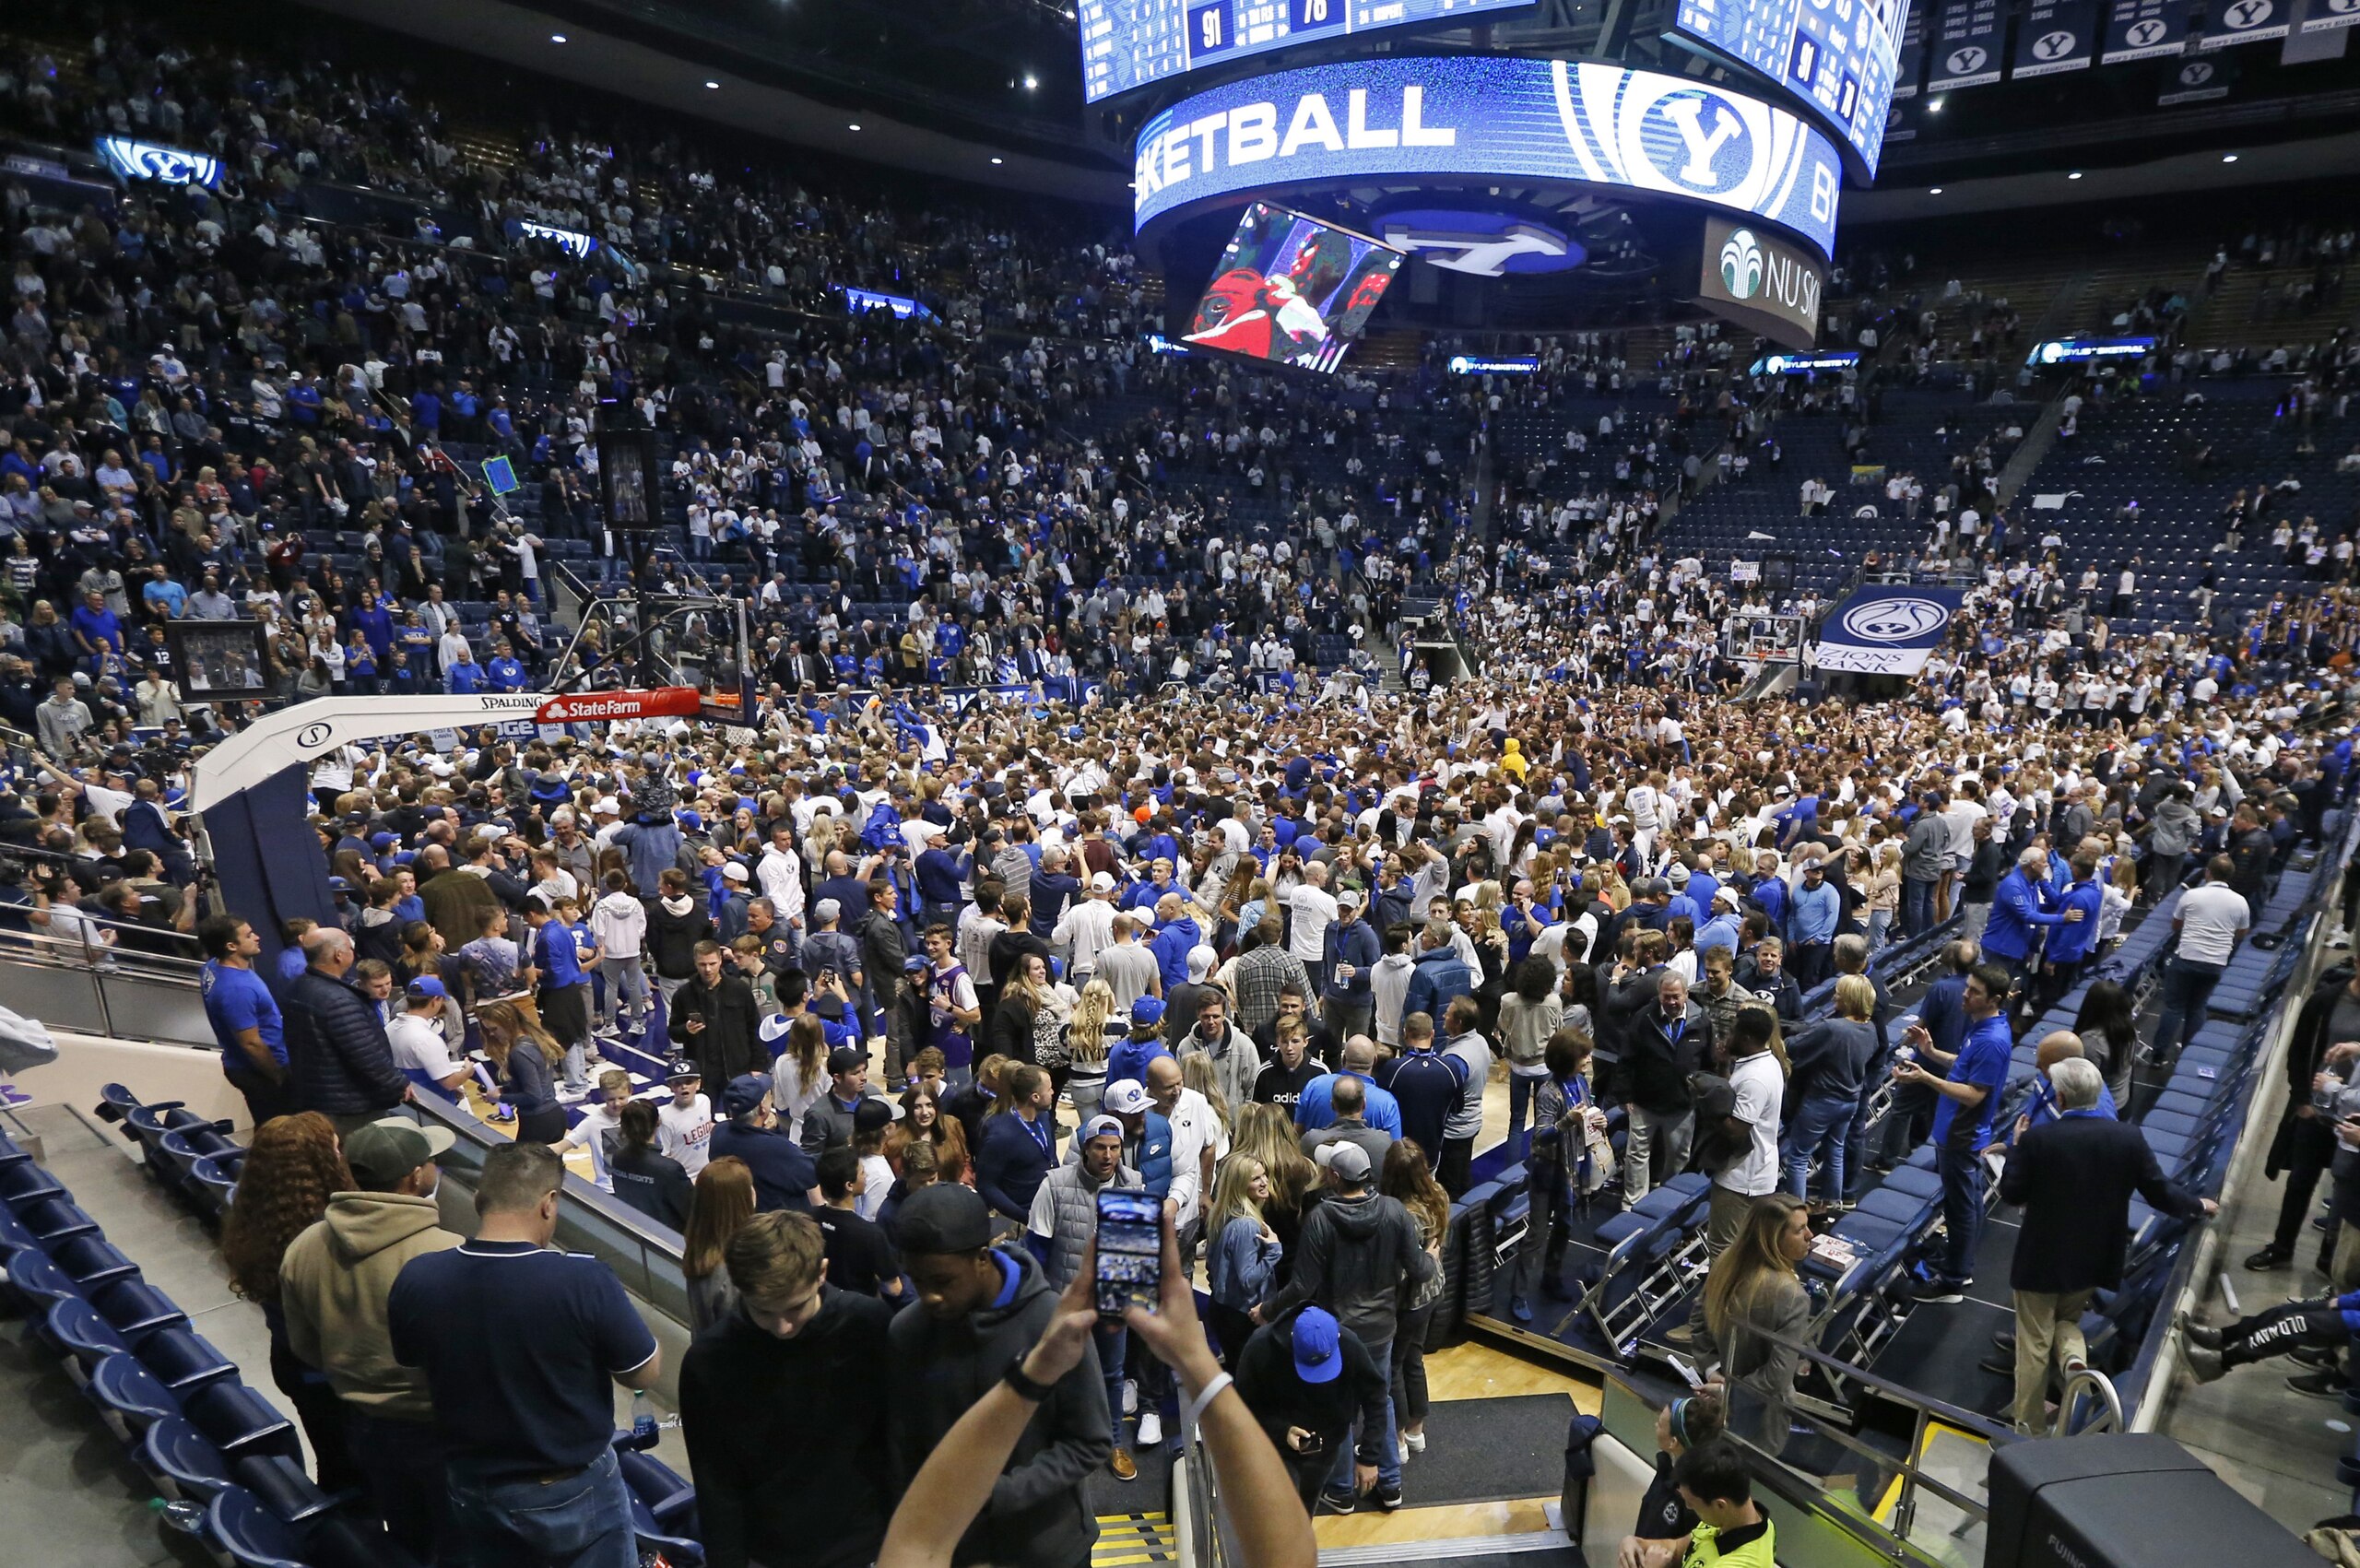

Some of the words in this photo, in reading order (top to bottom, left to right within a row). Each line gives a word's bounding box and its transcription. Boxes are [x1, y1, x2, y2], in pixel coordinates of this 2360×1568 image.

[1202, 8, 1222, 49] 91
[1765, 251, 1801, 308] NU
[155, 651, 171, 664] 12
[1823, 648, 1904, 663] ZIONS
[1817, 657, 1894, 673] BANK
[481, 695, 543, 710] SPALDING
[1273, 1092, 1301, 1103] adid
[683, 1121, 711, 1146] LEGIO
[2278, 1315, 2307, 1335] OLD
[2248, 1325, 2280, 1350] NAVY
